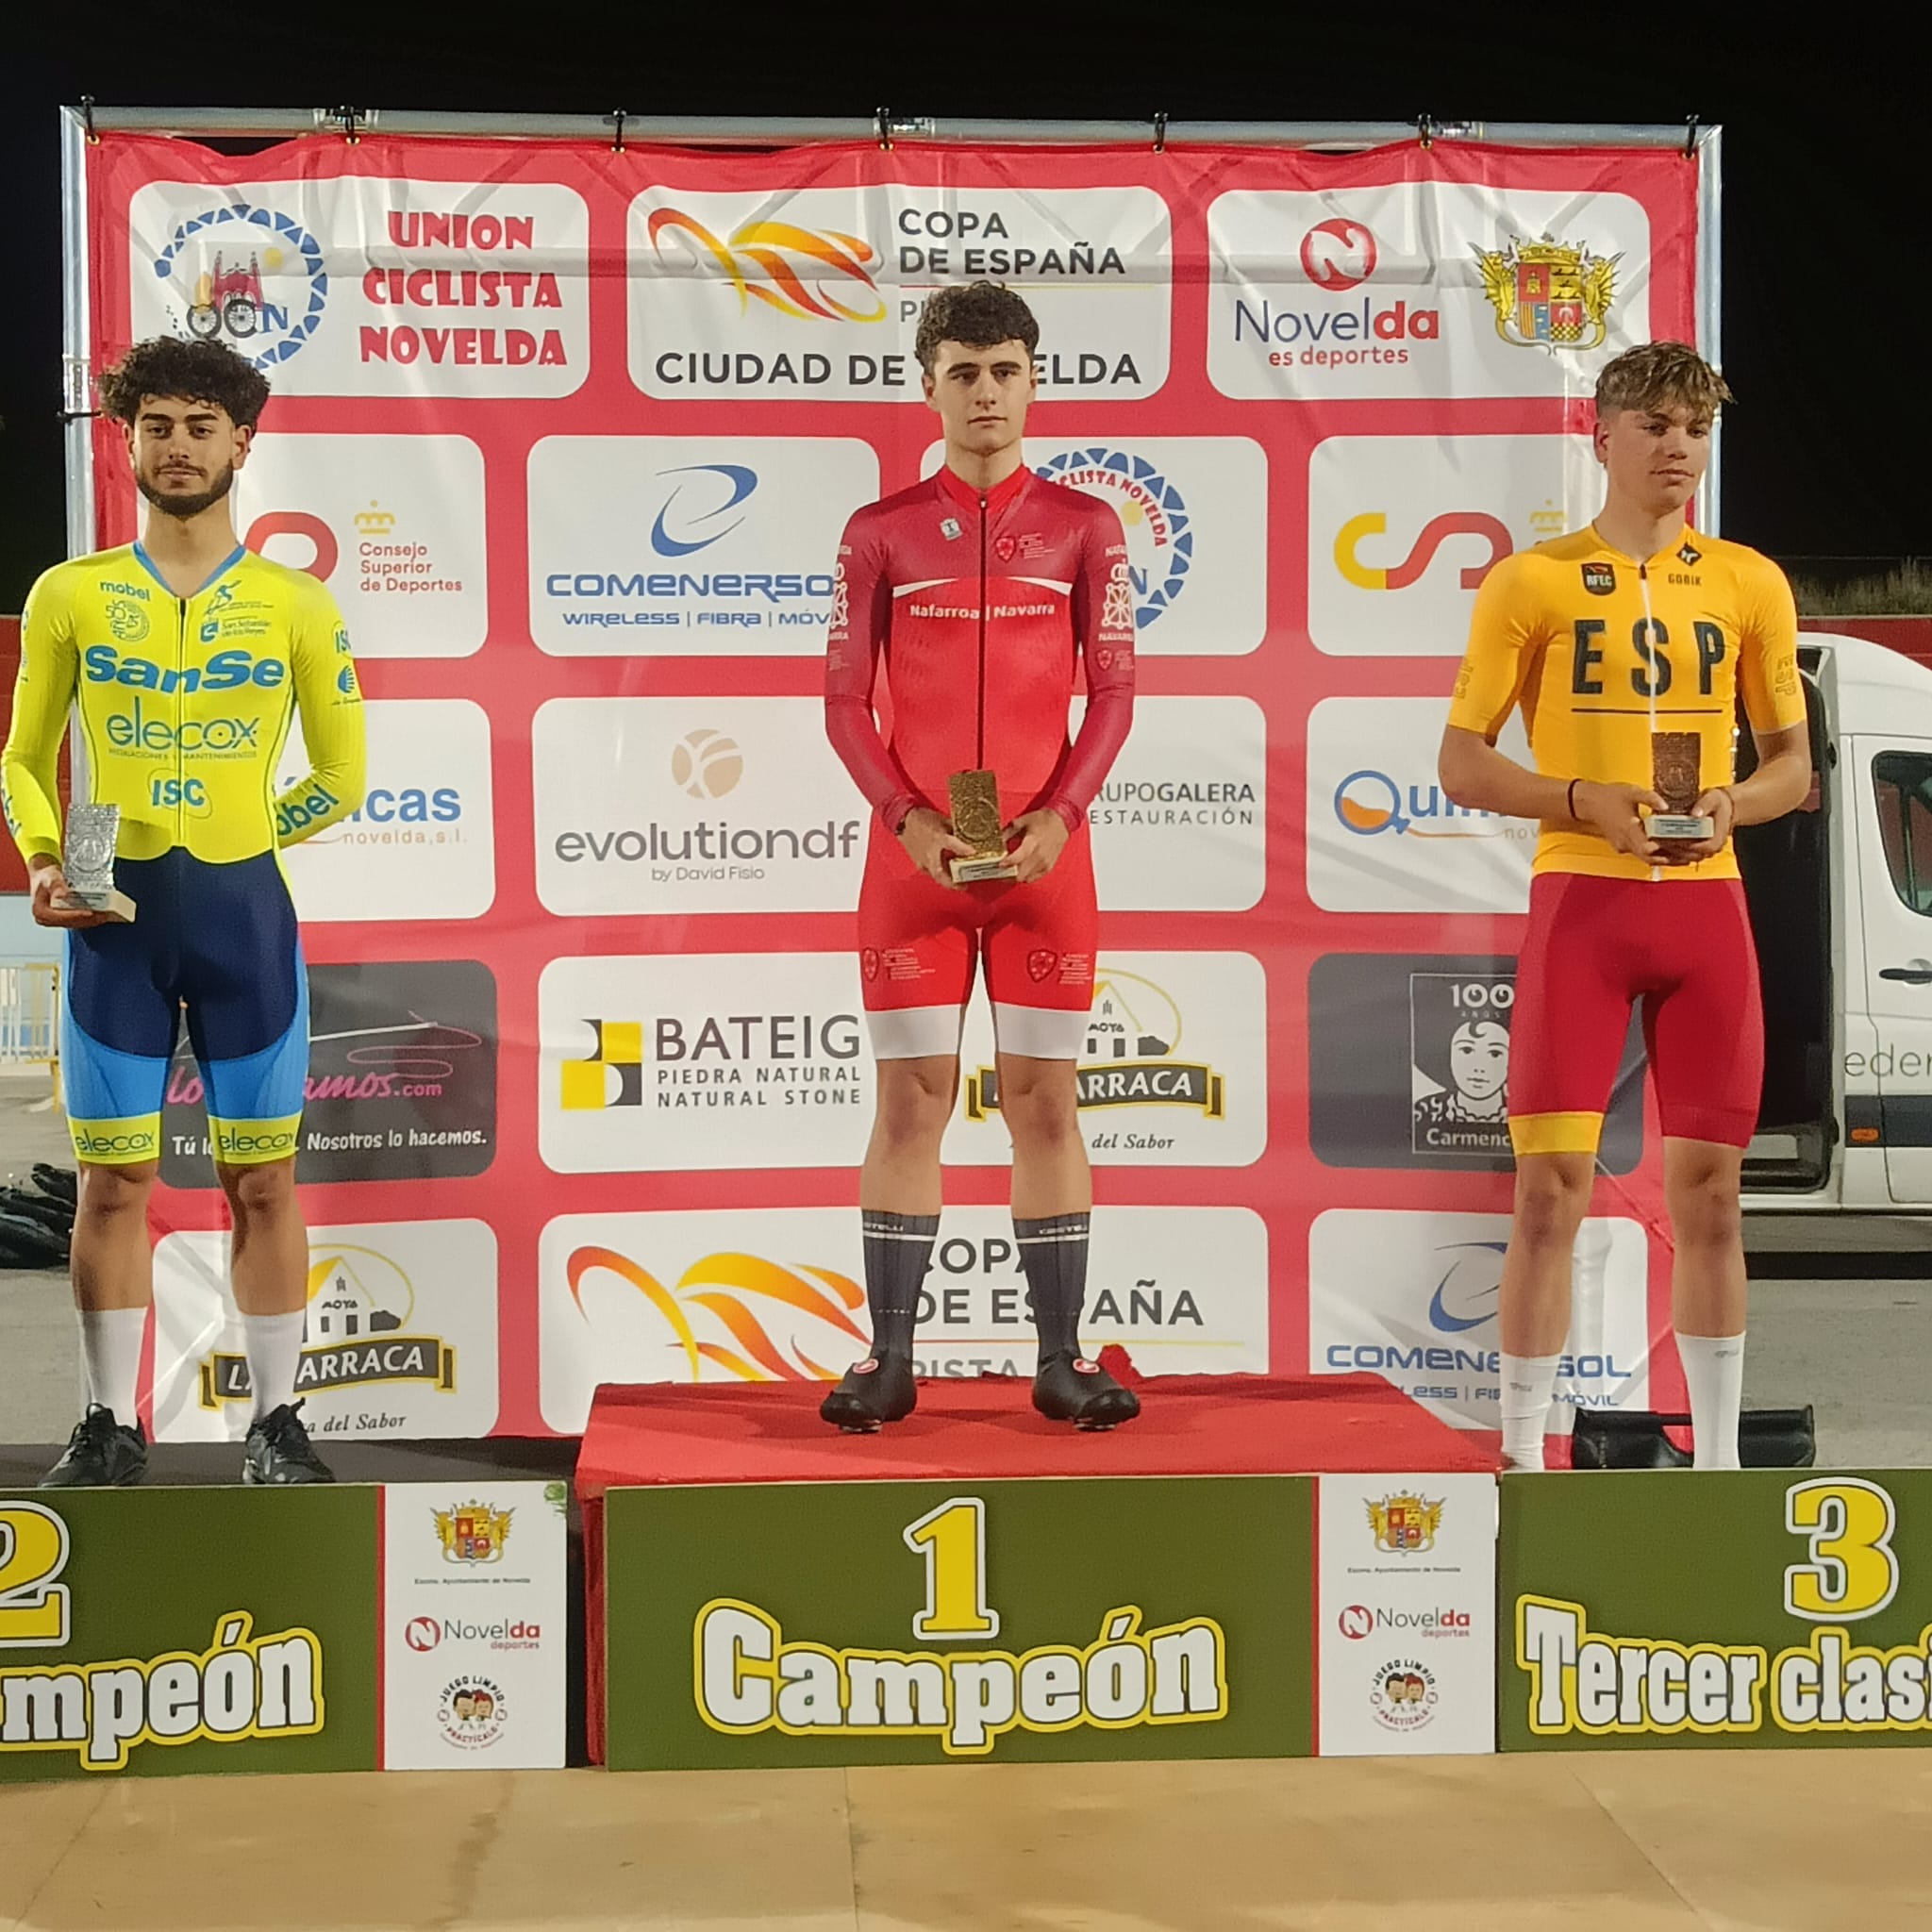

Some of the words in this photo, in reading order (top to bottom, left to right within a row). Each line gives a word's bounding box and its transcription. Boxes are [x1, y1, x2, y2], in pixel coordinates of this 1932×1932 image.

[388, 211, 533, 250] UNION
[898, 208, 1009, 238] COPA
[899, 247, 949, 274] DE
[964, 242, 1125, 275] ESPAÑA
[362, 268, 562, 308] CICLISTA
[1235, 297, 1439, 342] Novelda
[359, 325, 567, 365] NOVELDA
[1269, 351, 1293, 366] es
[1300, 345, 1408, 369] deportes
[656, 352, 831, 384] CIUDAD
[849, 355, 906, 385] DE
[1036, 353, 1141, 384] ELDA
[1120, 478, 1168, 546] NOVELDA
[359, 541, 427, 559] Consejo
[360, 559, 432, 575] Superior
[100, 580, 150, 602] mobel
[360, 578, 380, 591] de
[386, 577, 462, 594] Deportes
[546, 574, 834, 603] COMENERSO
[778, 608, 831, 625] MÓV
[909, 604, 980, 619] Nafarroa
[993, 604, 1056, 618] Navarra
[85, 644, 284, 695] SanSe
[106, 696, 261, 751] elecox
[151, 778, 205, 807] ISC
[1100, 782, 1256, 803] UPOGALERA
[275, 783, 340, 837] obel
[1090, 807, 1253, 824] ESTAURACIÓN
[555, 821, 860, 862] evolutiondf
[651, 867, 672, 882] by
[676, 866, 724, 881] David
[729, 865, 765, 879] Fisio
[656, 1014, 860, 1061] BATEIG
[658, 1068, 742, 1085] PIEDRA
[756, 1066, 861, 1083] NATURAL
[658, 1090, 767, 1108] NATURAL
[784, 1088, 861, 1106] STONE
[75, 1128, 155, 1152] elecox
[172, 1136, 195, 1156] Tú
[308, 1132, 382, 1151] Nosotros
[388, 1129, 403, 1147] lo
[408, 1128, 487, 1147] hacemos.
[1091, 1134, 1118, 1149] del
[1124, 1133, 1174, 1149] Sabor
[297, 1345, 424, 1384] ARRACA
[324, 1416, 348, 1432] del
[356, 1415, 407, 1431] Sabor
[1785, 1477, 1899, 1621] 3
[0, 1500, 71, 1647] 2
[903, 1498, 999, 1640] 1
[444, 1617, 541, 1640] Novelda
[1376, 1607, 1470, 1627] Novelda
[490, 1641, 541, 1652] deportes
[1421, 1628, 1471, 1640] deportes
[699, 1604, 1224, 1750] Campeón
[1521, 1599, 1762, 1730] Tercer
[0, 1616, 320, 1765] mpeón
